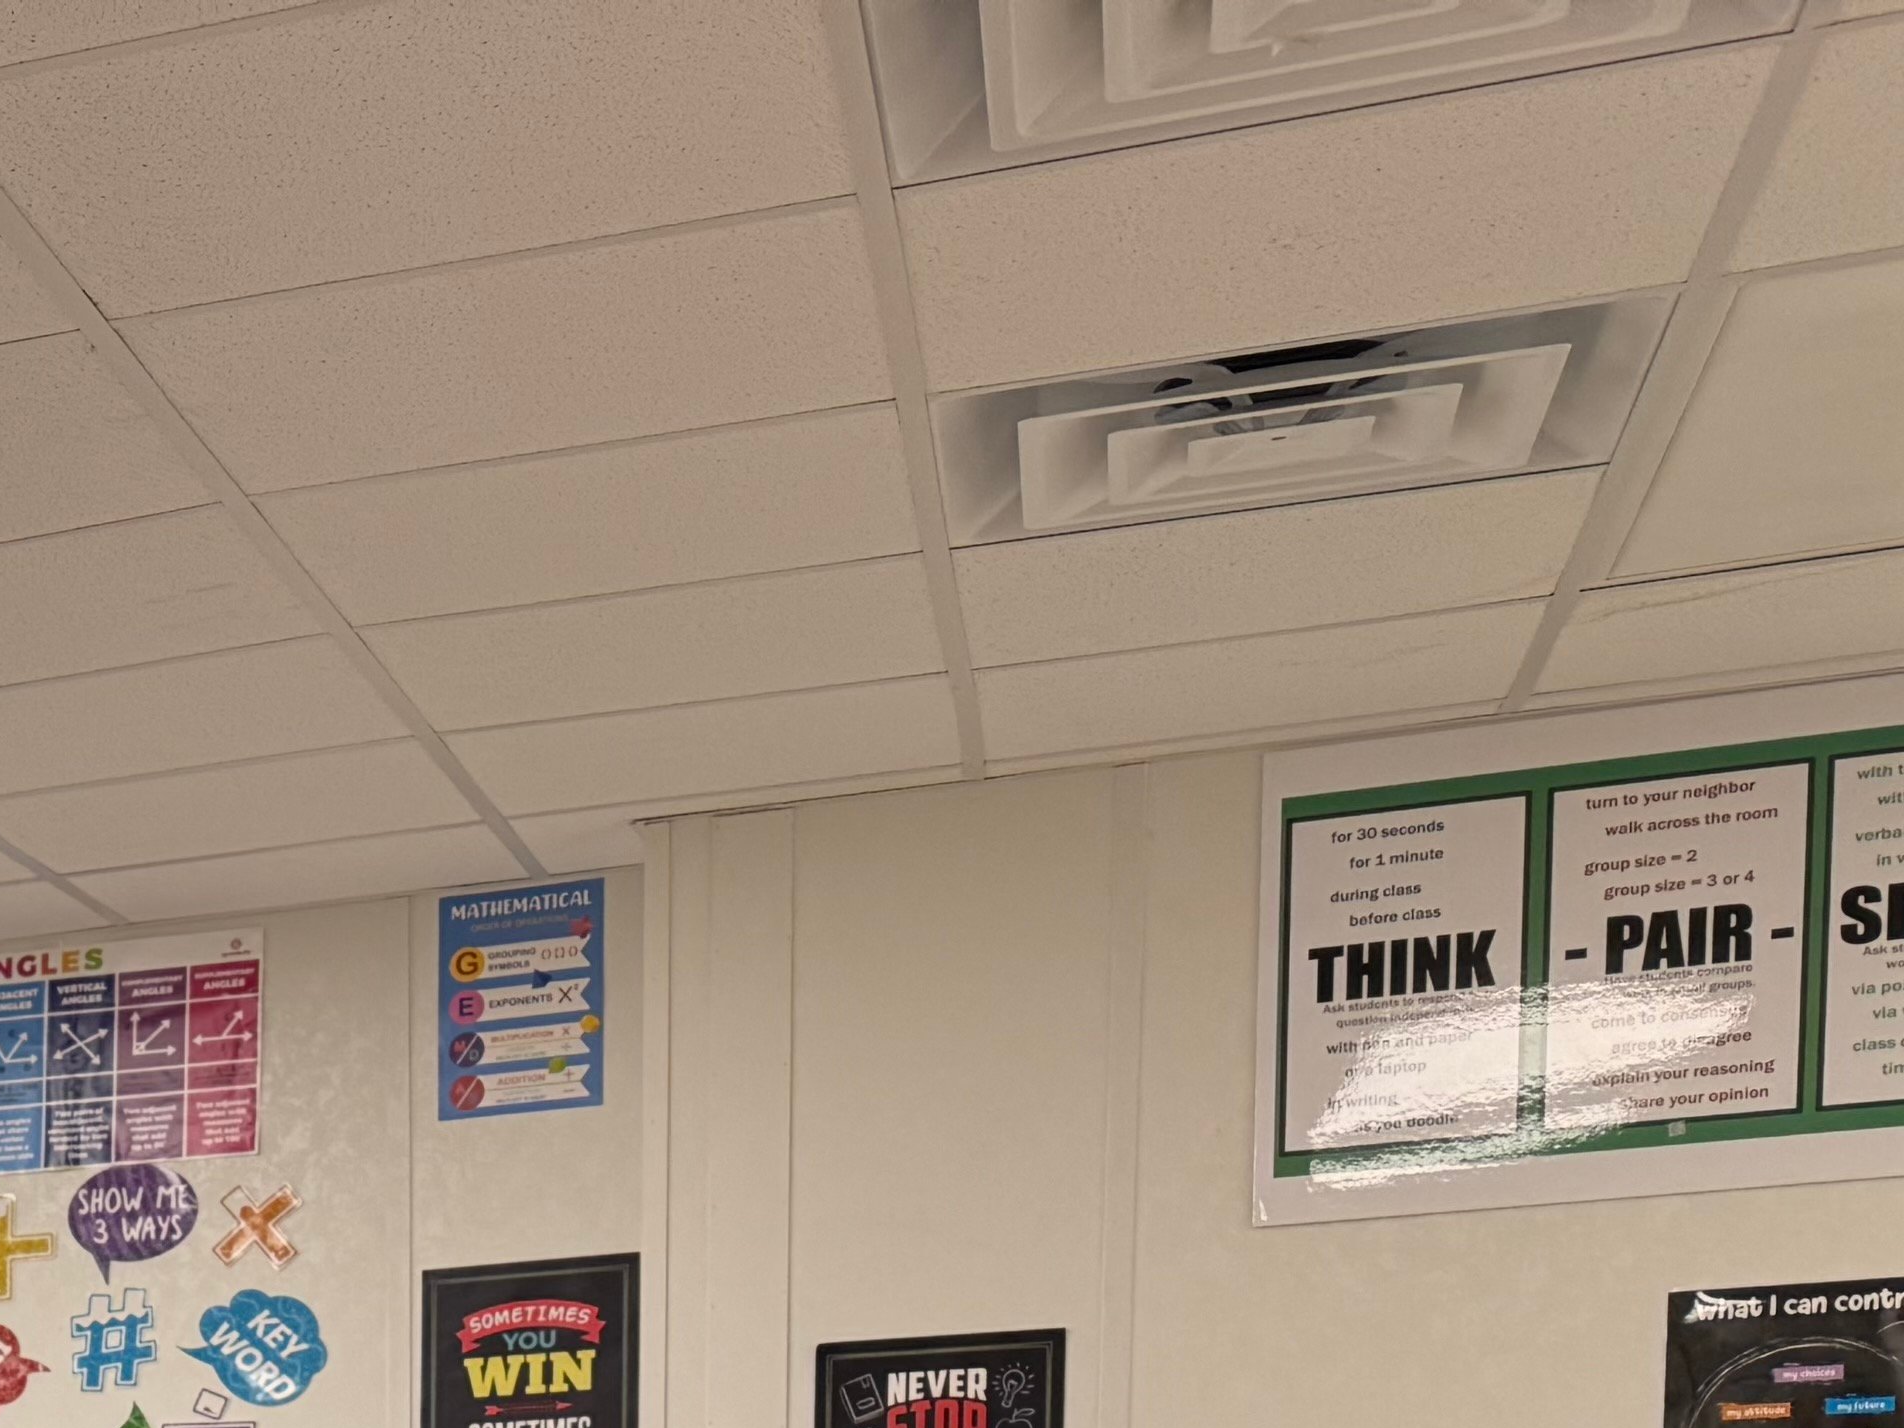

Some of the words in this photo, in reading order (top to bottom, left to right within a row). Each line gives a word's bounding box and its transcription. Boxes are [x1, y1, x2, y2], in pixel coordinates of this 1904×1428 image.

[1586, 798, 1618, 810] turn
[1623, 794, 1639, 806] to
[1643, 790, 1679, 807] your
[1682, 781, 1756, 799] neighbor
[1331, 830, 1352, 844] for
[1356, 827, 1378, 841] 30
[1381, 820, 1445, 838] seconds
[1605, 821, 1643, 837] walk
[1647, 817, 1700, 832] across
[1704, 812, 1731, 825] the
[1735, 807, 1779, 822] room
[1349, 856, 1370, 870] for
[1376, 854, 1386, 866] 1
[1389, 849, 1444, 865] minute
[1584, 858, 1631, 877] group
[1634, 854, 1666, 868] size
[1686, 850, 1698, 863] 2
[1330, 888, 1380, 903] during
[1382, 883, 1422, 898] class
[1604, 883, 1651, 901] group
[1654, 878, 1686, 892] size
[1706, 874, 1718, 887] 3
[1722, 874, 1740, 886] or
[1744, 870, 1756, 883] 4
[450, 889, 592, 921] MATHEMATICAL
[1349, 912, 1398, 927] before
[1402, 906, 1442, 922] class
[1604, 902, 1754, 976] PAIR
[1308, 929, 1496, 1003] THINK
[489, 993, 554, 1010] EXPONENTS
[1592, 1071, 1650, 1088] explain
[1654, 1068, 1688, 1084] your
[1693, 1058, 1776, 1078] reasoning
[1668, 1092, 1705, 1109] your
[1708, 1087, 1769, 1104] opinion
[77, 1189, 142, 1216] SHOW
[155, 1183, 189, 1211] ME
[93, 1218, 109, 1244] 3
[120, 1214, 184, 1242] WAYS
[469, 1304, 592, 1334] SOMETIMES
[1697, 1294, 1762, 1322] what
[1783, 1294, 1828, 1316] can
[246, 1308, 310, 1360] KEY
[502, 1330, 556, 1351] YOU
[209, 1322, 300, 1402] WORD
[463, 1349, 596, 1399] WIN
[1782, 1370, 1798, 1380] my
[1800, 1367, 1836, 1378] choices
[887, 1368, 988, 1406] NEVER
